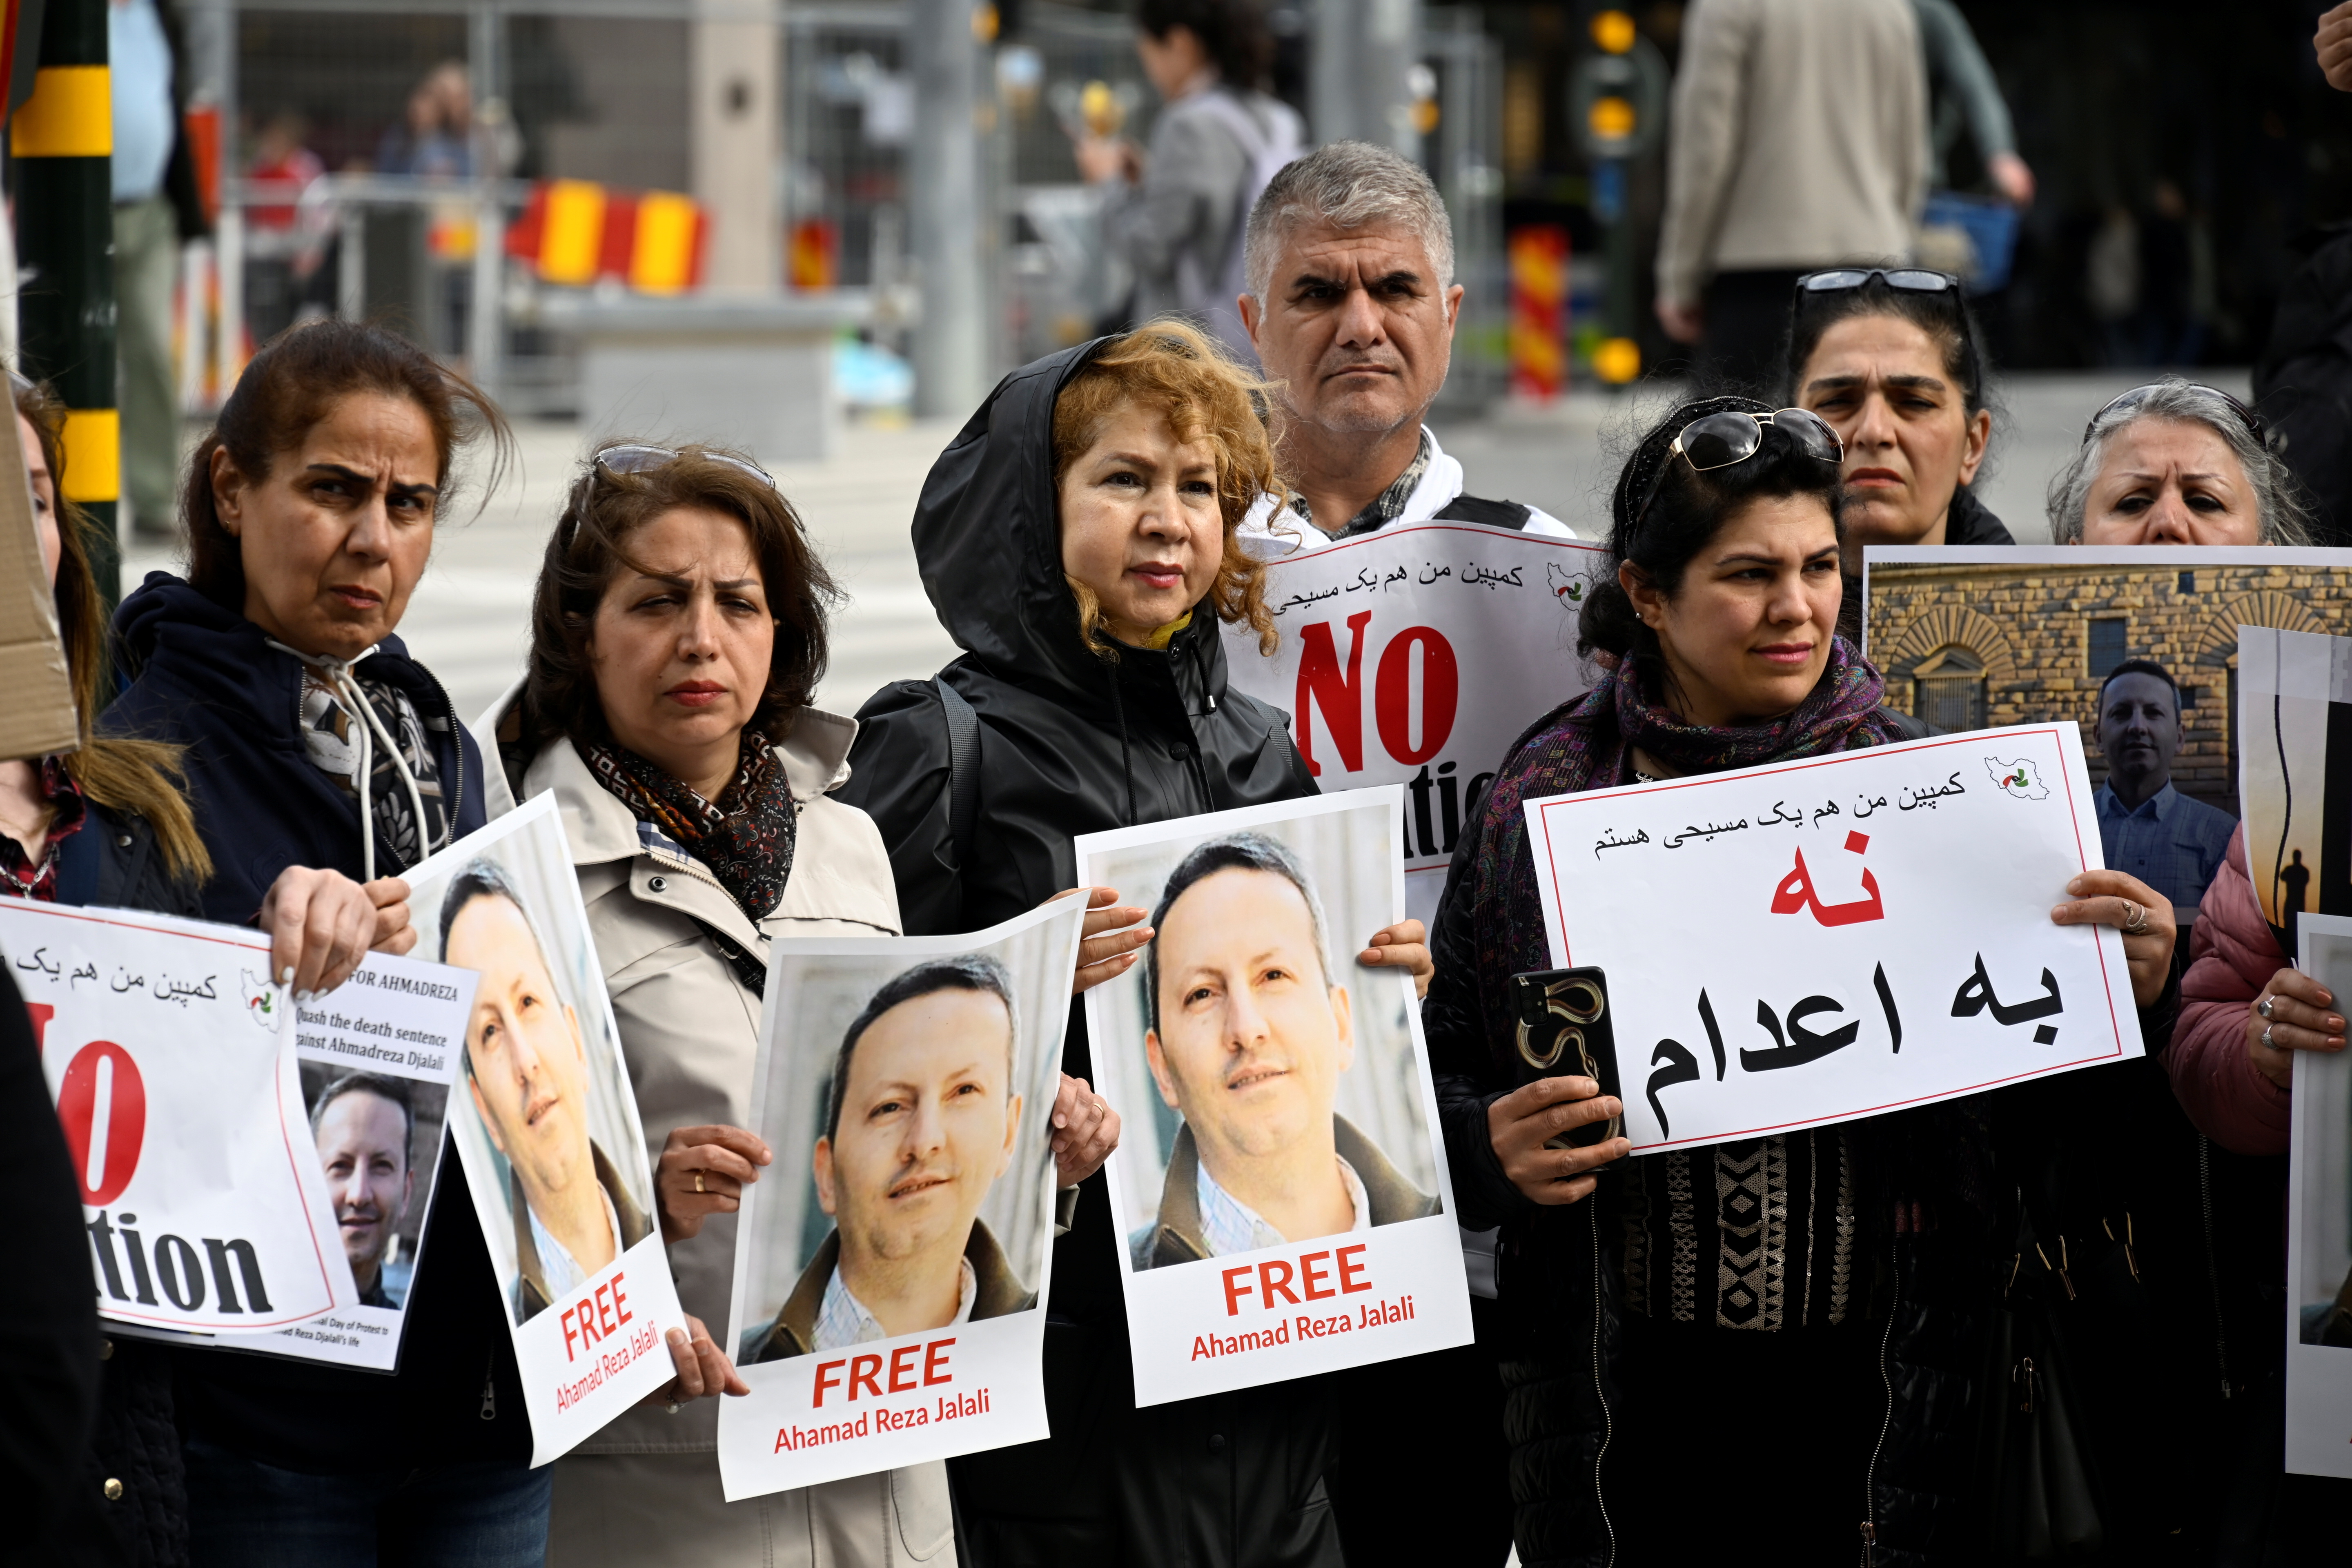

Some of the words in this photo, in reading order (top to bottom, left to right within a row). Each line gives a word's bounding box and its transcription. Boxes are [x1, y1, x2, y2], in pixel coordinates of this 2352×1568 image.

[1345, 567, 1377, 592] یک
[1384, 565, 1408, 594] هم
[1419, 562, 1452, 585] من
[1461, 561, 1523, 591] کمپین
[1272, 586, 1339, 617] مسیحی
[1295, 609, 1458, 777] NO
[1853, 793, 1888, 818] من
[1898, 771, 1966, 811] کمپین
[1757, 800, 1803, 829] یک
[1813, 799, 1840, 830] هم
[1594, 827, 1650, 862] هستم
[1663, 818, 1748, 849] مسیحی
[1770, 830, 1885, 928] نه
[16, 947, 60, 982] یک
[70, 962, 98, 991] هم
[110, 966, 144, 993] من
[154, 973, 217, 1007] کمپین
[378, 975, 458, 1002] AHMADREZA
[1950, 950, 2064, 1046] به
[296, 1007, 327, 1025] Quash
[330, 1013, 351, 1030] the
[354, 1017, 392, 1038] death
[394, 1028, 448, 1047] sentence
[328, 1037, 405, 1064] Ahmadreza
[407, 1051, 445, 1071] Djalali
[1646, 960, 1902, 1142] اعدام
[1221, 1243, 1373, 1317] FREE
[560, 1271, 633, 1363] FREE
[1191, 1319, 1290, 1362] Ahamad
[1295, 1314, 1352, 1341] Reza
[1358, 1294, 1415, 1330] Jalali
[557, 1359, 603, 1414] Ahamad
[602, 1347, 630, 1381] Reza
[630, 1320, 659, 1361] Jalali
[812, 1337, 957, 1409] FREE
[774, 1411, 869, 1454] Ahamad
[875, 1407, 929, 1434] Reza
[934, 1388, 990, 1423] Jalali
